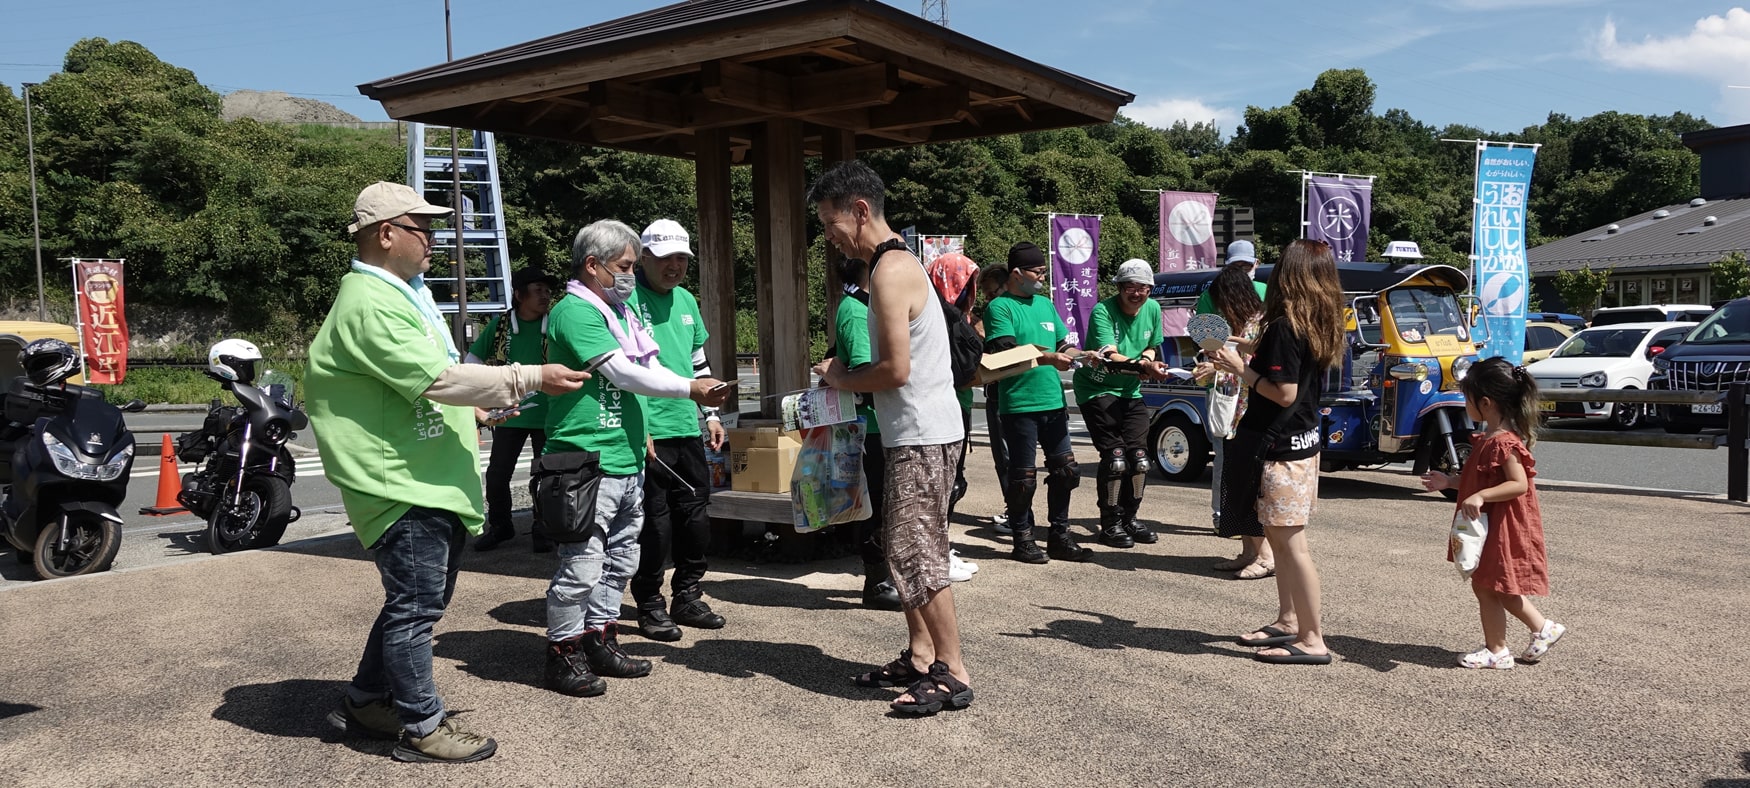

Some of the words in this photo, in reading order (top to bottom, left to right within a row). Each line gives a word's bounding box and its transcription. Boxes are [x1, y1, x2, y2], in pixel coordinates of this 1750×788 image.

[1324, 203, 1353, 233] 米
[1481, 184, 1502, 270] うれしが
[1502, 184, 1521, 270] おいしが
[1080, 267, 1093, 298] 道の駅
[1061, 278, 1080, 346] 妹子の郷
[90, 304, 121, 381] 近江牛
[1094, 368, 1108, 383] Bik
[598, 391, 607, 410] enjoy
[606, 380, 622, 428] BikeD
[1698, 404, 1721, 413] 26-02
[413, 422, 427, 441] Let's
[426, 402, 444, 438] Bik
[597, 412, 606, 429] Let's
